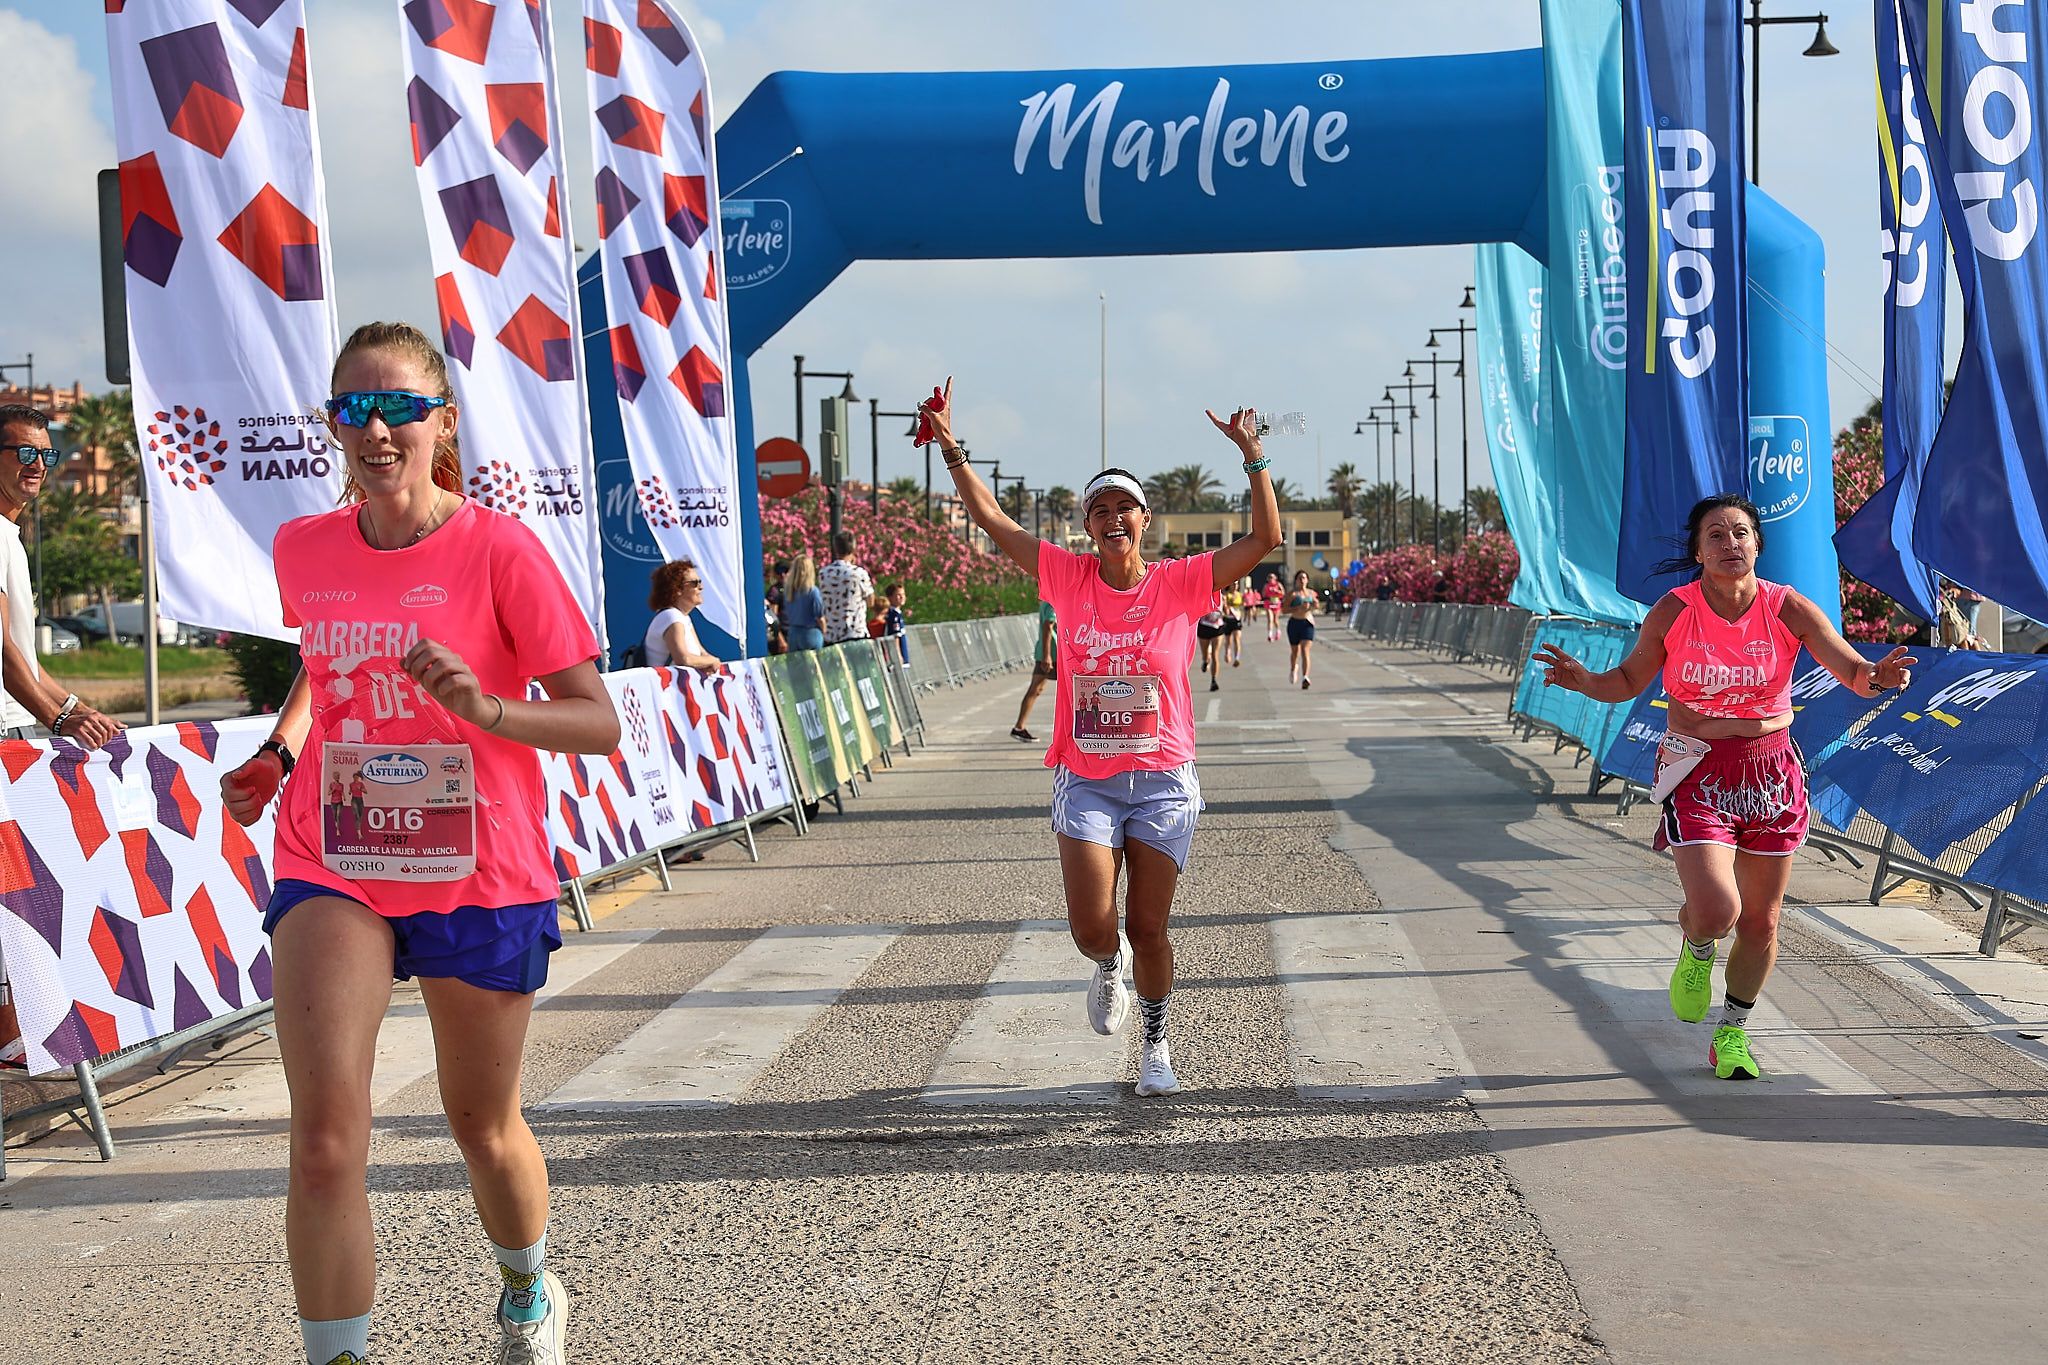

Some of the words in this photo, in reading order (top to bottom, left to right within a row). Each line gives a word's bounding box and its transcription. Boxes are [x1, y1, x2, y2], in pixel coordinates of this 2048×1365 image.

[1013, 77, 1350, 225] Marlene
[726, 219, 783, 257] rlene
[747, 264, 775, 281] ALPES
[1749, 440, 1804, 485] rlene
[1770, 492, 1799, 514] ALPES
[636, 545, 650, 555] DE
[303, 591, 357, 603] OYSHO
[301, 620, 419, 657] CARRERA
[1100, 711, 1133, 725] 016
[332, 756, 359, 766] SUMA
[366, 764, 424, 777] ASTURIANA
[367, 808, 424, 831] 016
[383, 834, 409, 845] 2387
[337, 844, 370, 854] CARRERA
[371, 846, 381, 855] DE
[381, 846, 391, 855] LA
[392, 847, 416, 856] MUJER
[422, 847, 458, 856] VALENCIA
[339, 860, 385, 872] OYSHO
[411, 865, 458, 874] Santander
